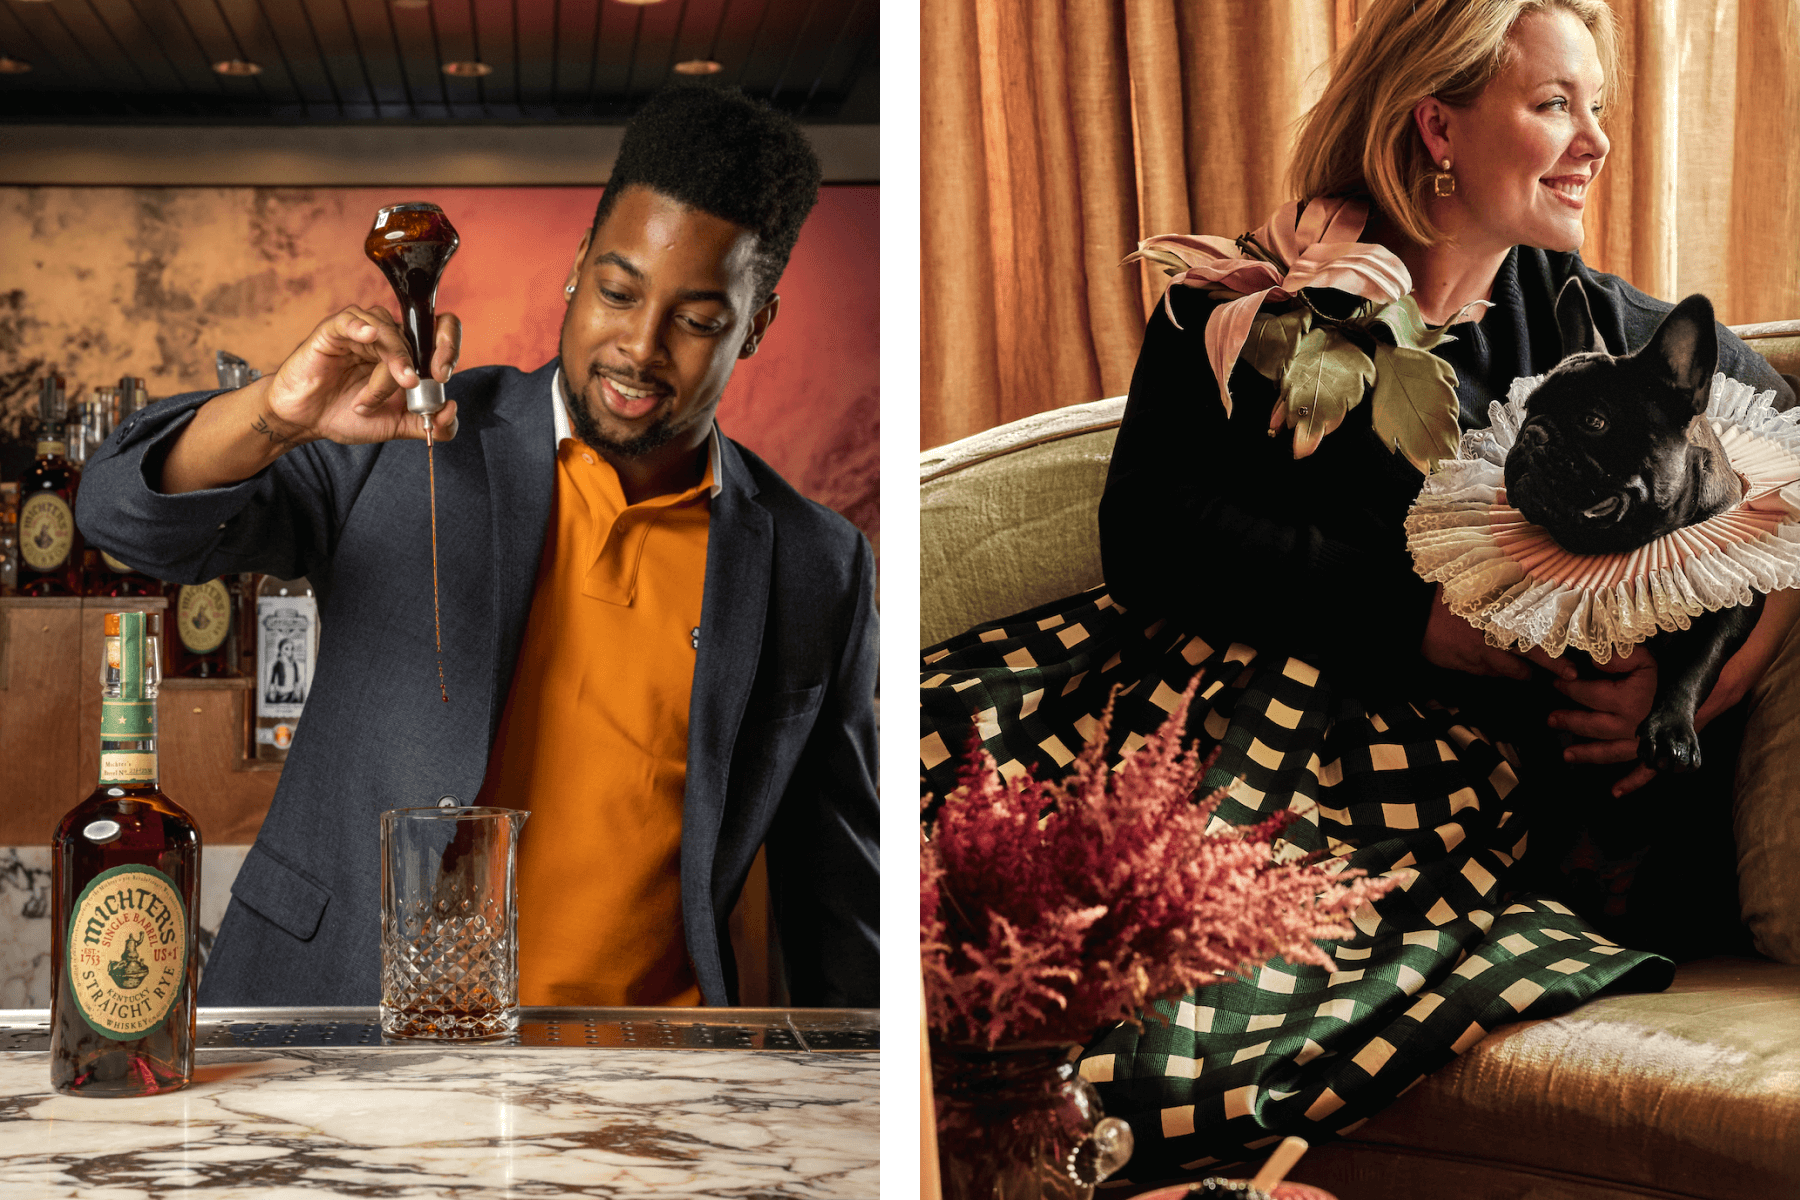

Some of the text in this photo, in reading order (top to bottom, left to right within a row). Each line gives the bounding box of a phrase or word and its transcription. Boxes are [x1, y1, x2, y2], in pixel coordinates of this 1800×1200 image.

[84, 888, 176, 947] MICHTER'S
[102, 913, 130, 947] SINGLE
[133, 913, 158, 947] BARREL
[81, 955, 100, 966] 1753
[83, 970, 153, 1019] STRAIGHT
[153, 966, 174, 999] RYE
[107, 988, 150, 1003] KENTUCKY
[106, 1019, 148, 1030] WHISKEY
